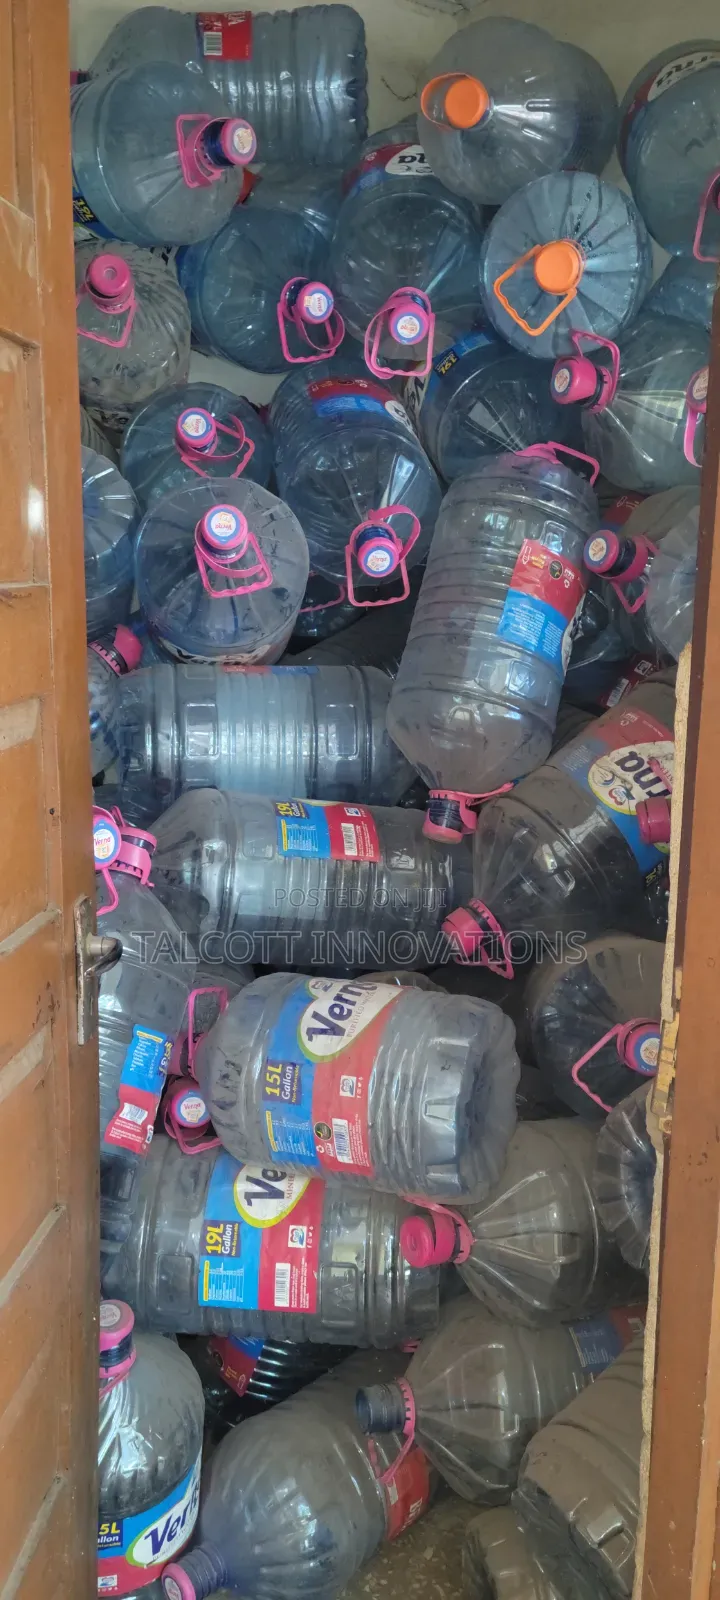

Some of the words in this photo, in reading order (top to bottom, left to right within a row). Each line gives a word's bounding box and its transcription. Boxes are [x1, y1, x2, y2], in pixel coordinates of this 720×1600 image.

[78, 199, 94, 218] 19L
[440, 354, 458, 374] 19L
[94, 837, 111, 845] Verna
[265, 1063, 282, 1096] 15L
[281, 1066, 293, 1100] Gallon
[183, 1102, 201, 1110] Verna
[205, 1223, 224, 1254] 19L
[222, 1224, 233, 1255] Gallon
[98, 1522, 120, 1535] 5L
[98, 1535, 119, 1543] llon
